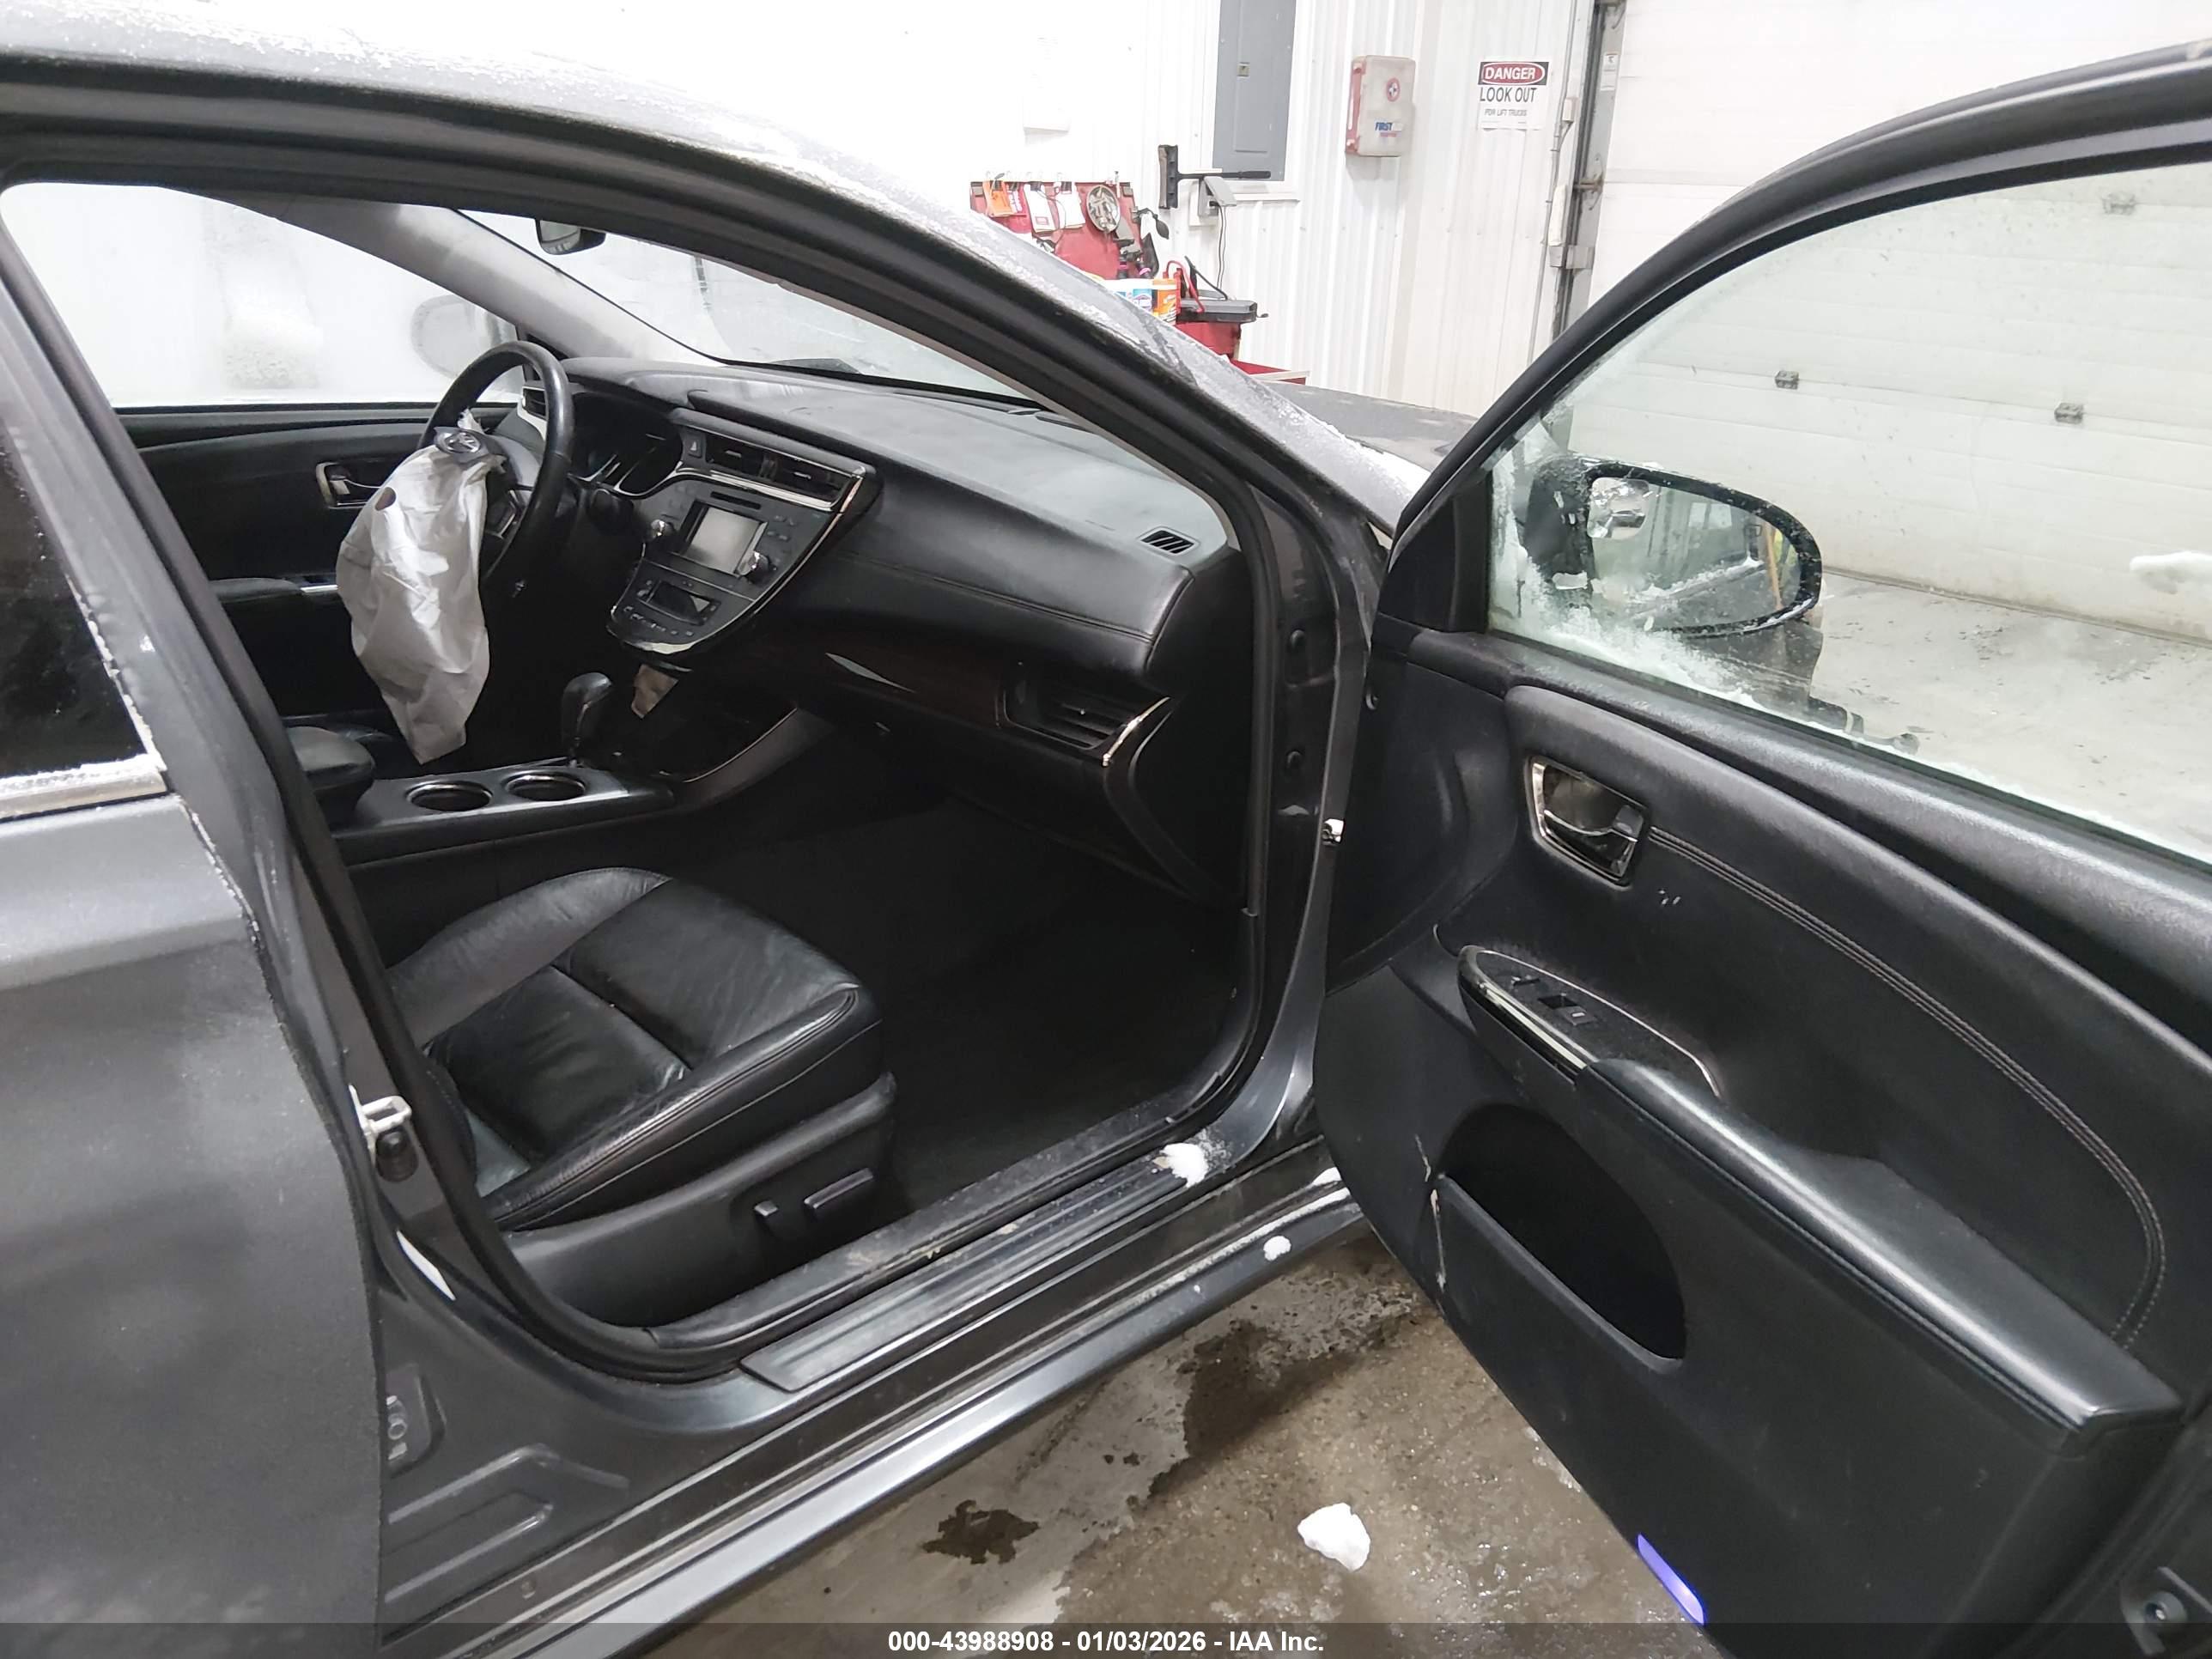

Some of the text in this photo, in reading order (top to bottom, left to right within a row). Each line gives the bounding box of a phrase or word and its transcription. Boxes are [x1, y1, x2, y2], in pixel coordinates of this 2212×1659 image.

[1484, 67, 1536, 80] DANGER
[1480, 87, 1537, 102] LOOK OUT
